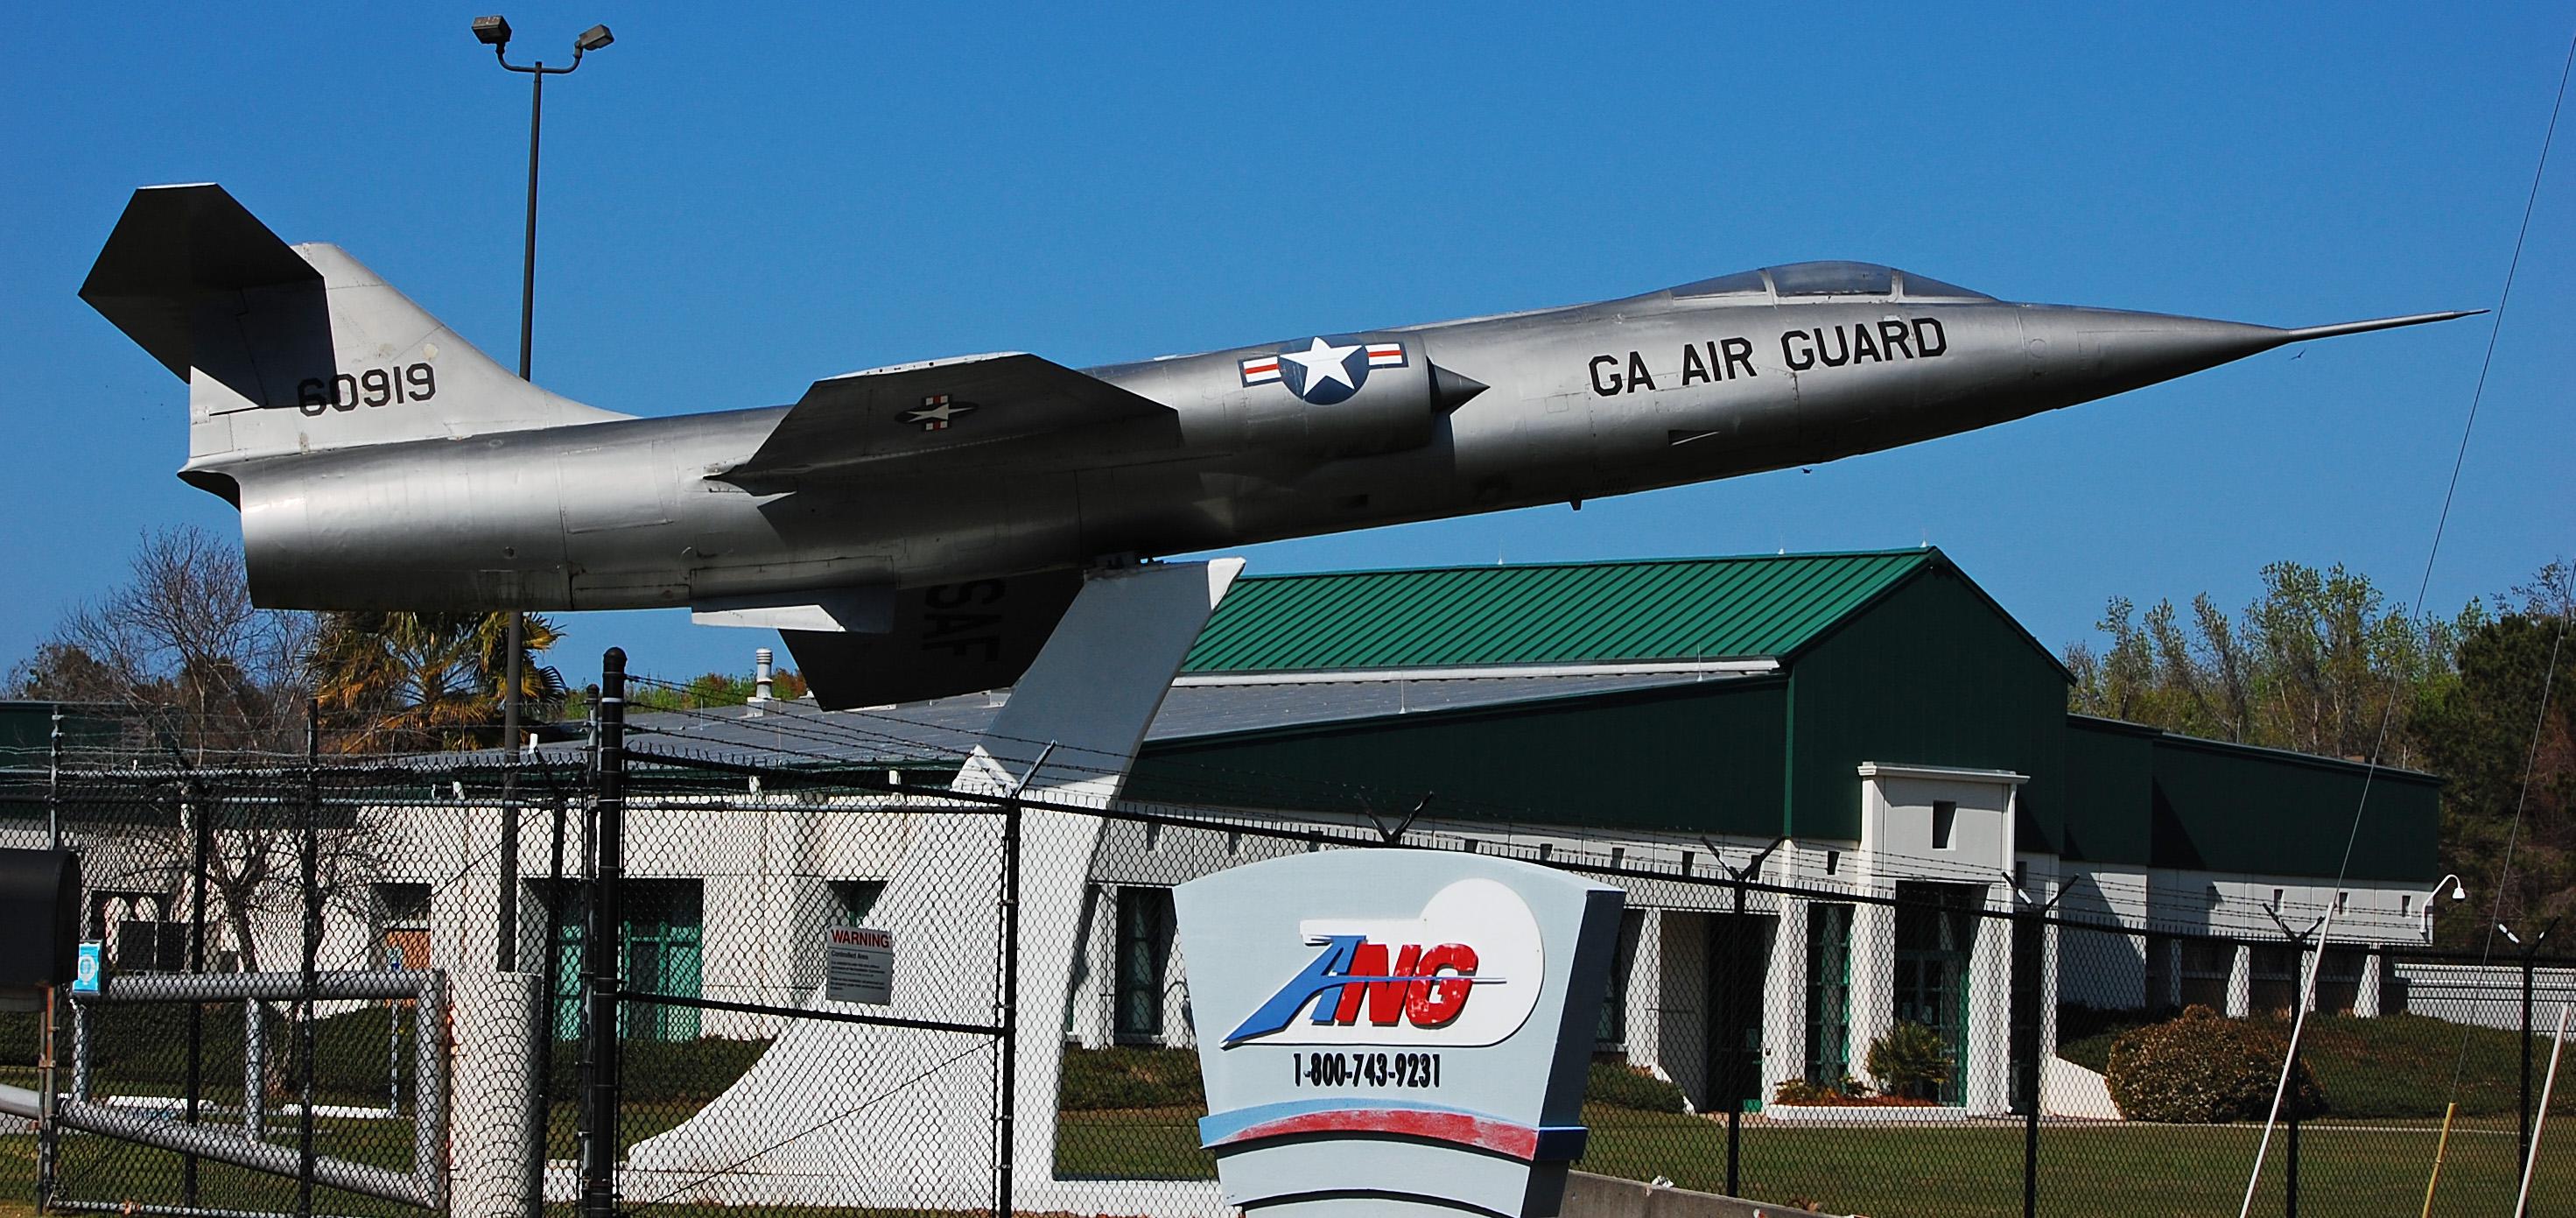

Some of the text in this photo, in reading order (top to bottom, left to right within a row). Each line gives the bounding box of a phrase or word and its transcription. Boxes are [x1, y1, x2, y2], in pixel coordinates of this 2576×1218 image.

[1588, 317, 1948, 397] GA AIR GUARD
[297, 363, 436, 417] 60919
[830, 929, 890, 947] WARNING
[1224, 934, 1479, 1044] ANG
[1293, 1053, 1441, 1088] 1-800-743-9231
